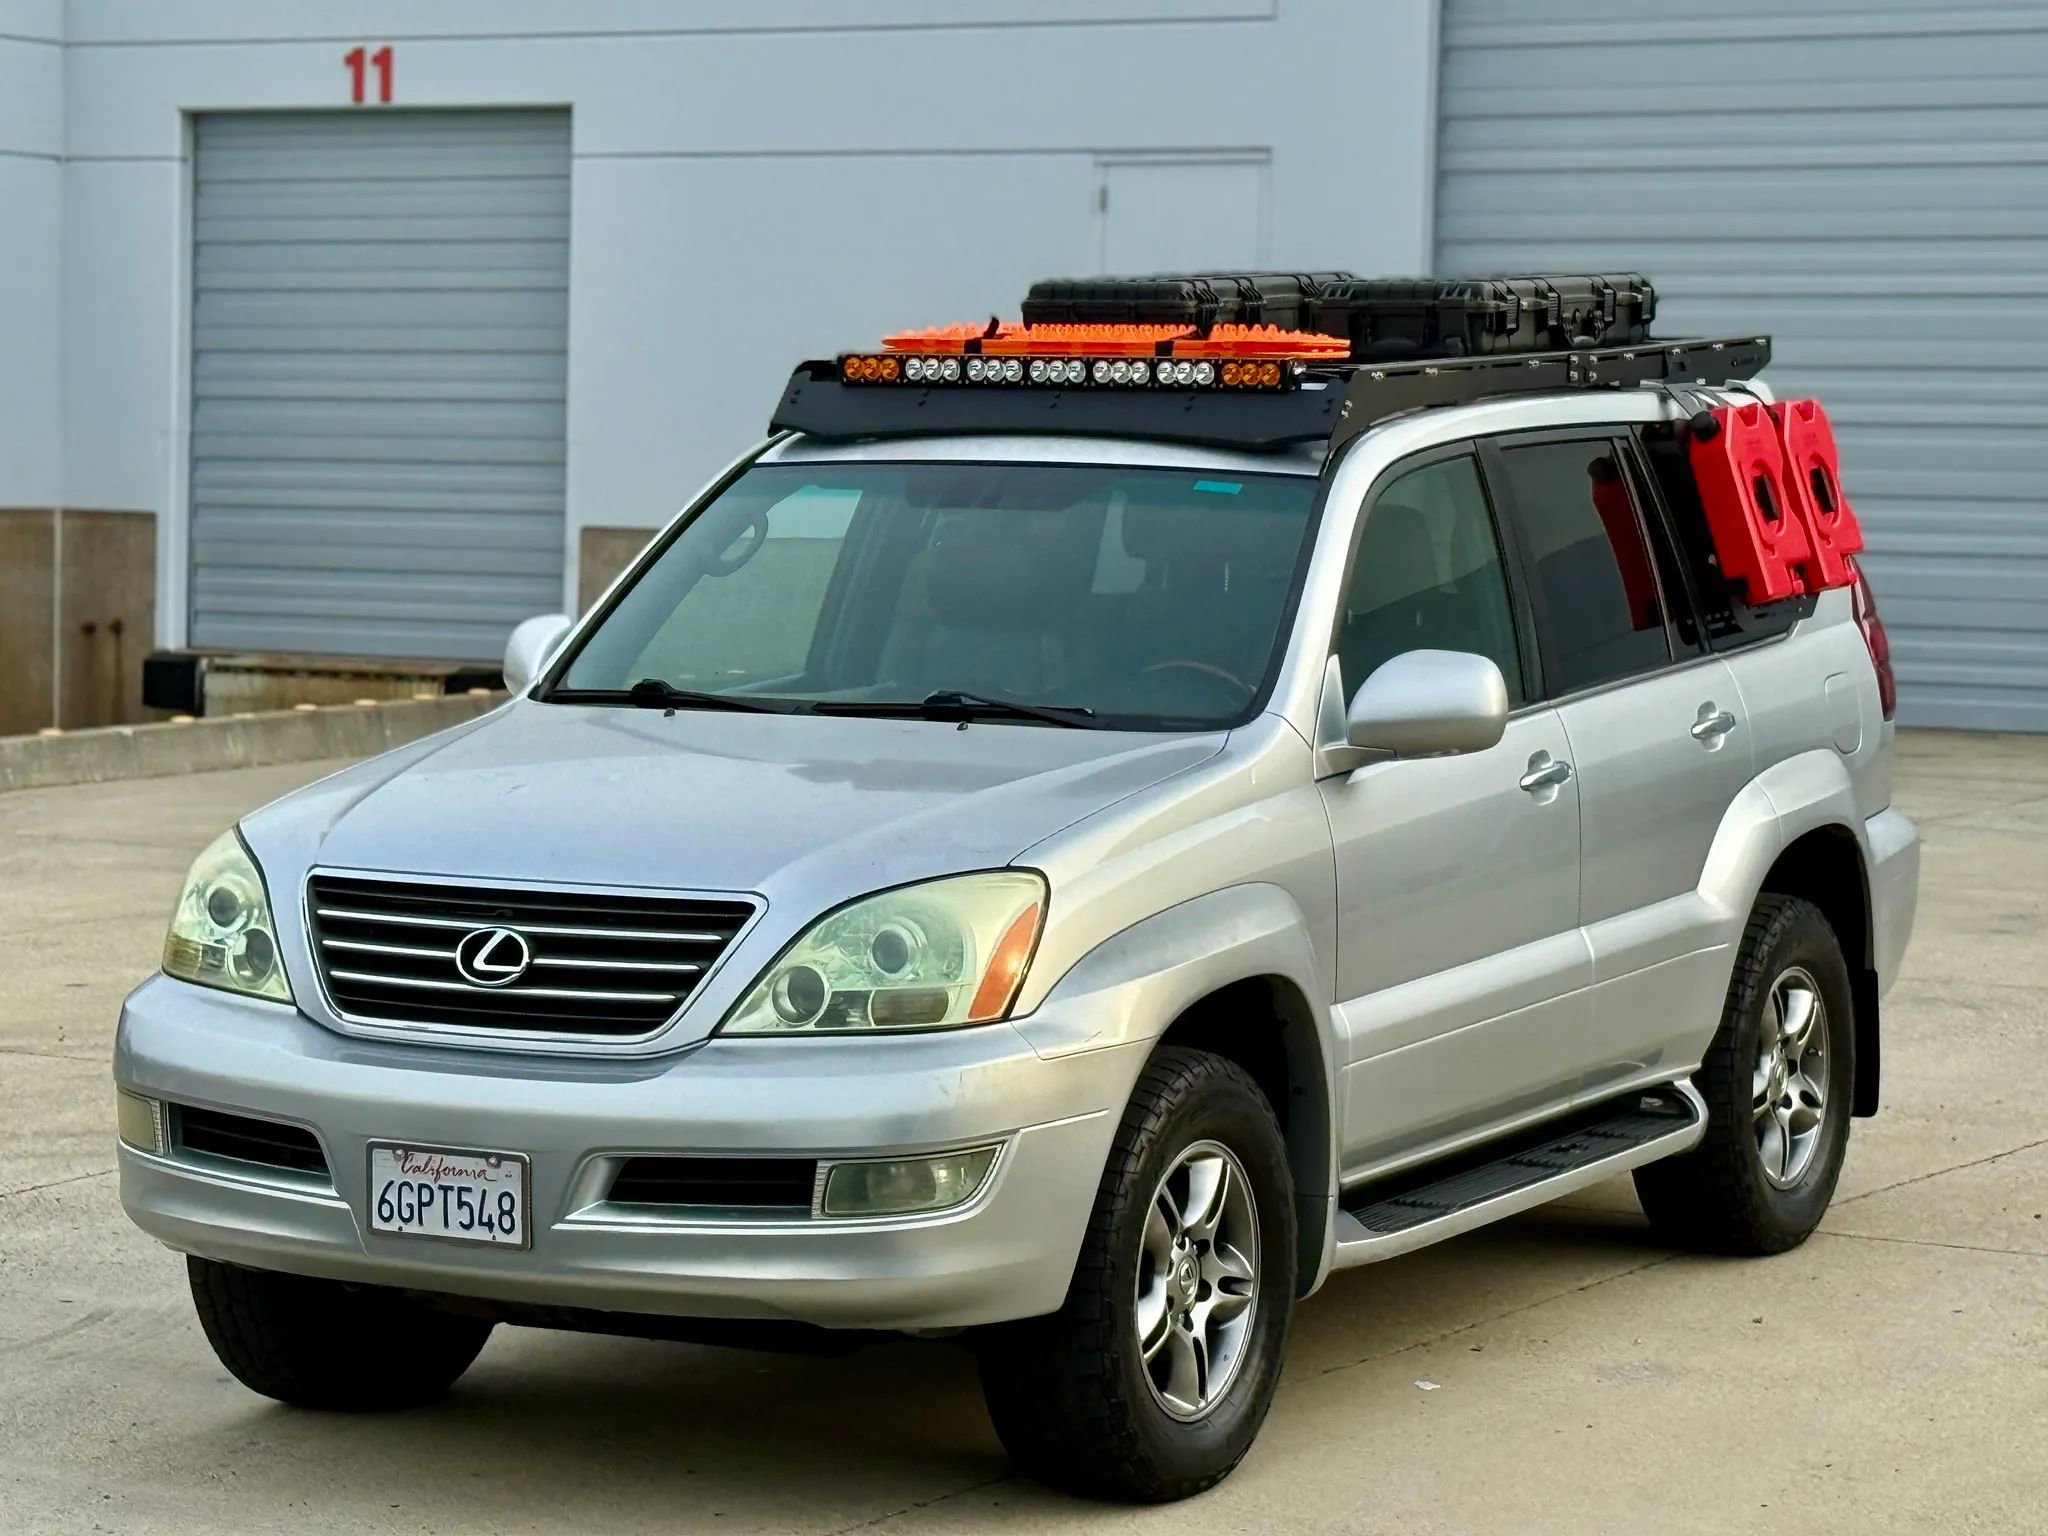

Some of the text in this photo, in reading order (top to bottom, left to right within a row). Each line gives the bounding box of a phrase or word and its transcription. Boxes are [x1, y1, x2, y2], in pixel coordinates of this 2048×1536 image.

[344, 46, 392, 102] 11
[401, 1152, 498, 1184] California
[377, 1180, 516, 1235] 6GPT548
